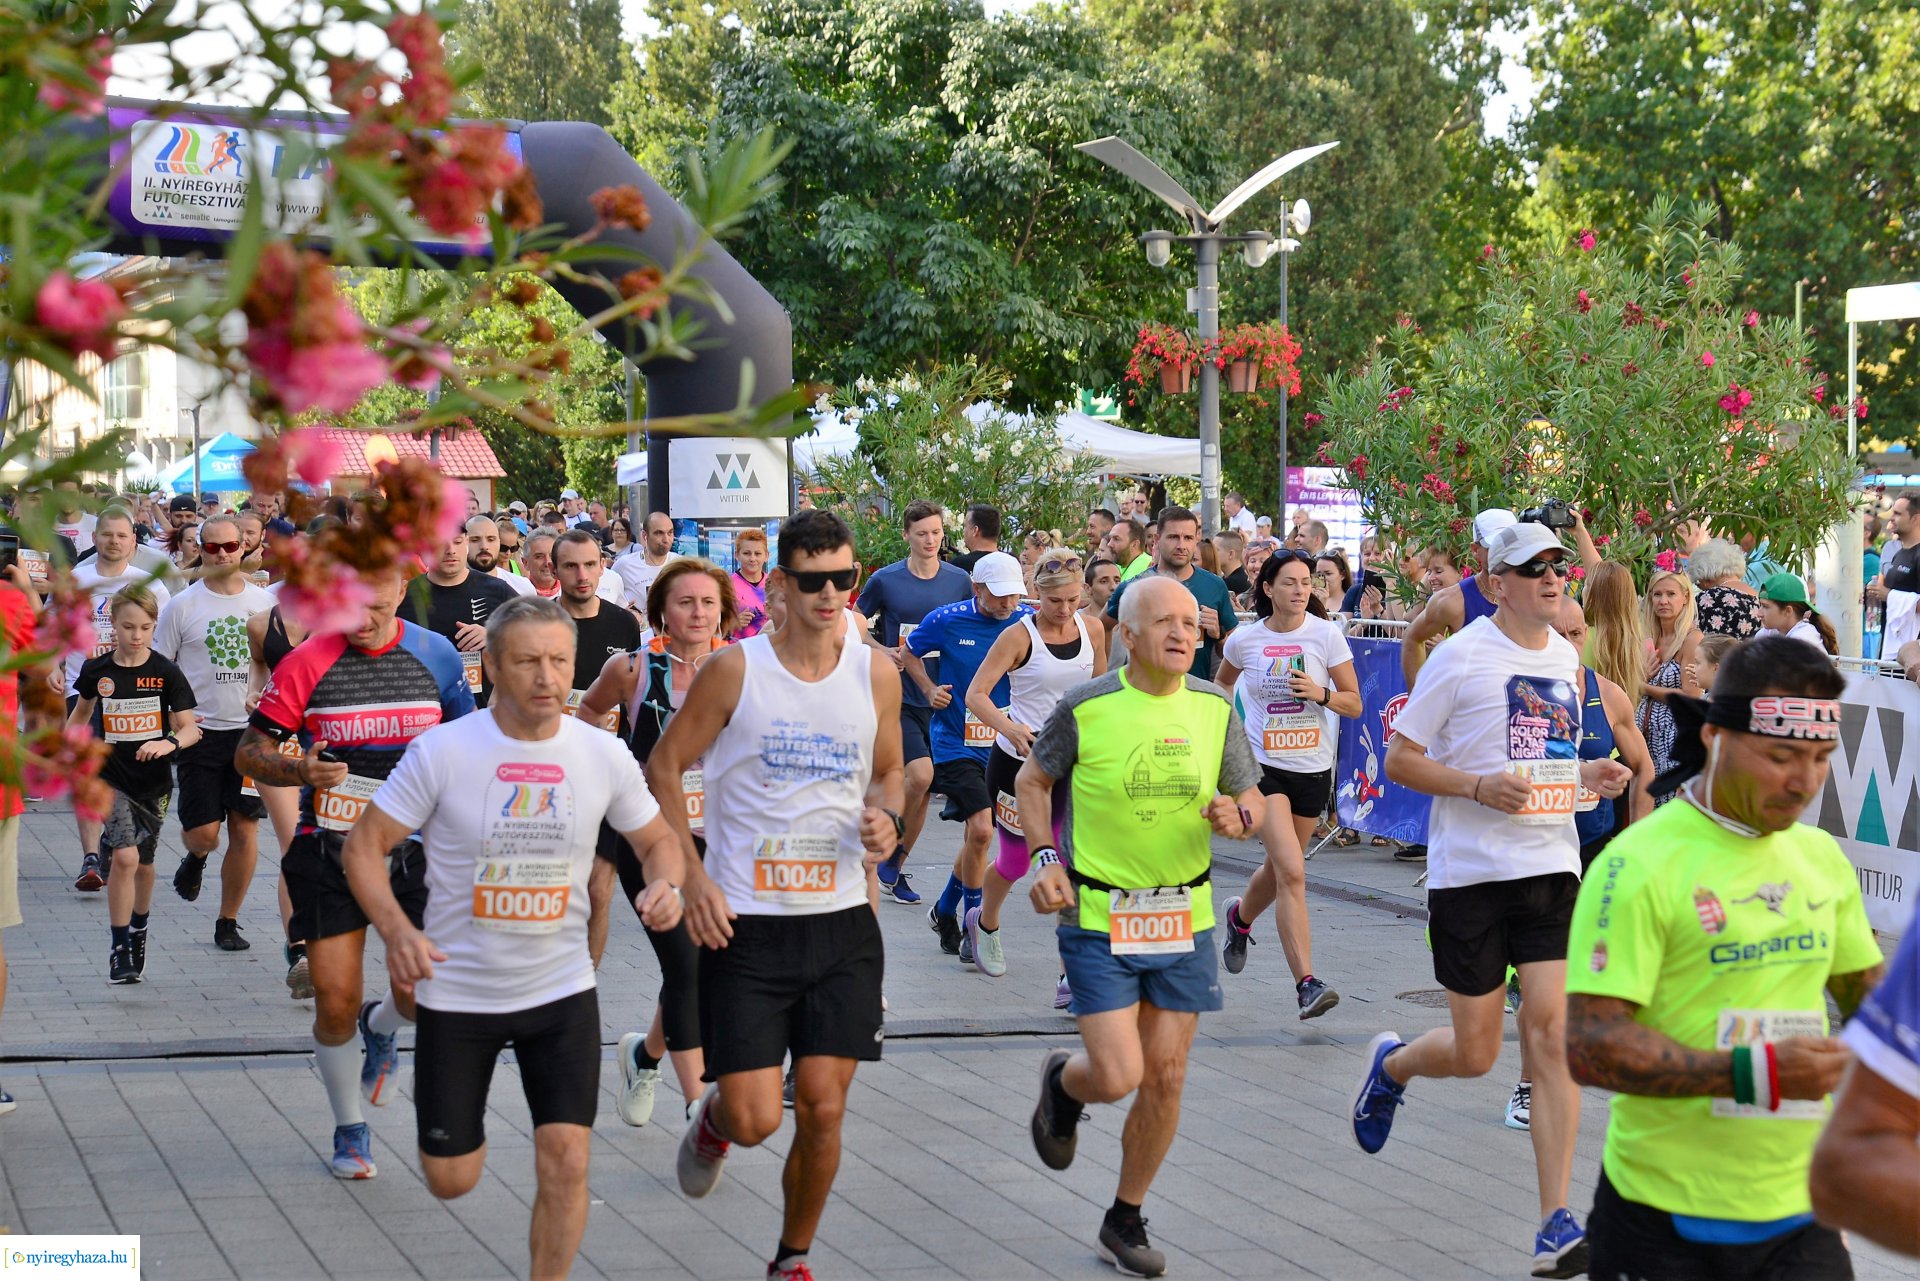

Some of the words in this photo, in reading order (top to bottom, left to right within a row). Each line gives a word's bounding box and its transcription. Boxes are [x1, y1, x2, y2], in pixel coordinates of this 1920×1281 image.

[143, 177, 156, 188] II.
[161, 176, 250, 194] NYÍREGYHÁZ
[143, 191, 248, 209] FUTÓFESZTIVÁ
[180, 212, 211, 222] sematic
[719, 494, 751, 503] WITTUR
[25, 560, 46, 571] 024
[958, 638, 976, 646] JAKO
[108, 715, 158, 732] 10120
[402, 714, 414, 726] ÉS
[969, 725, 995, 739] 100
[1267, 731, 1316, 748] 10002
[1509, 725, 1549, 738] KOLOR
[1510, 748, 1546, 759] NIGHT
[1520, 787, 1572, 811] 0028
[761, 863, 832, 889] 10043
[1856, 866, 1904, 903] ITTUR
[481, 889, 565, 918] 10006
[1116, 914, 1185, 940] 10001
[1709, 929, 1815, 965] Gepard
